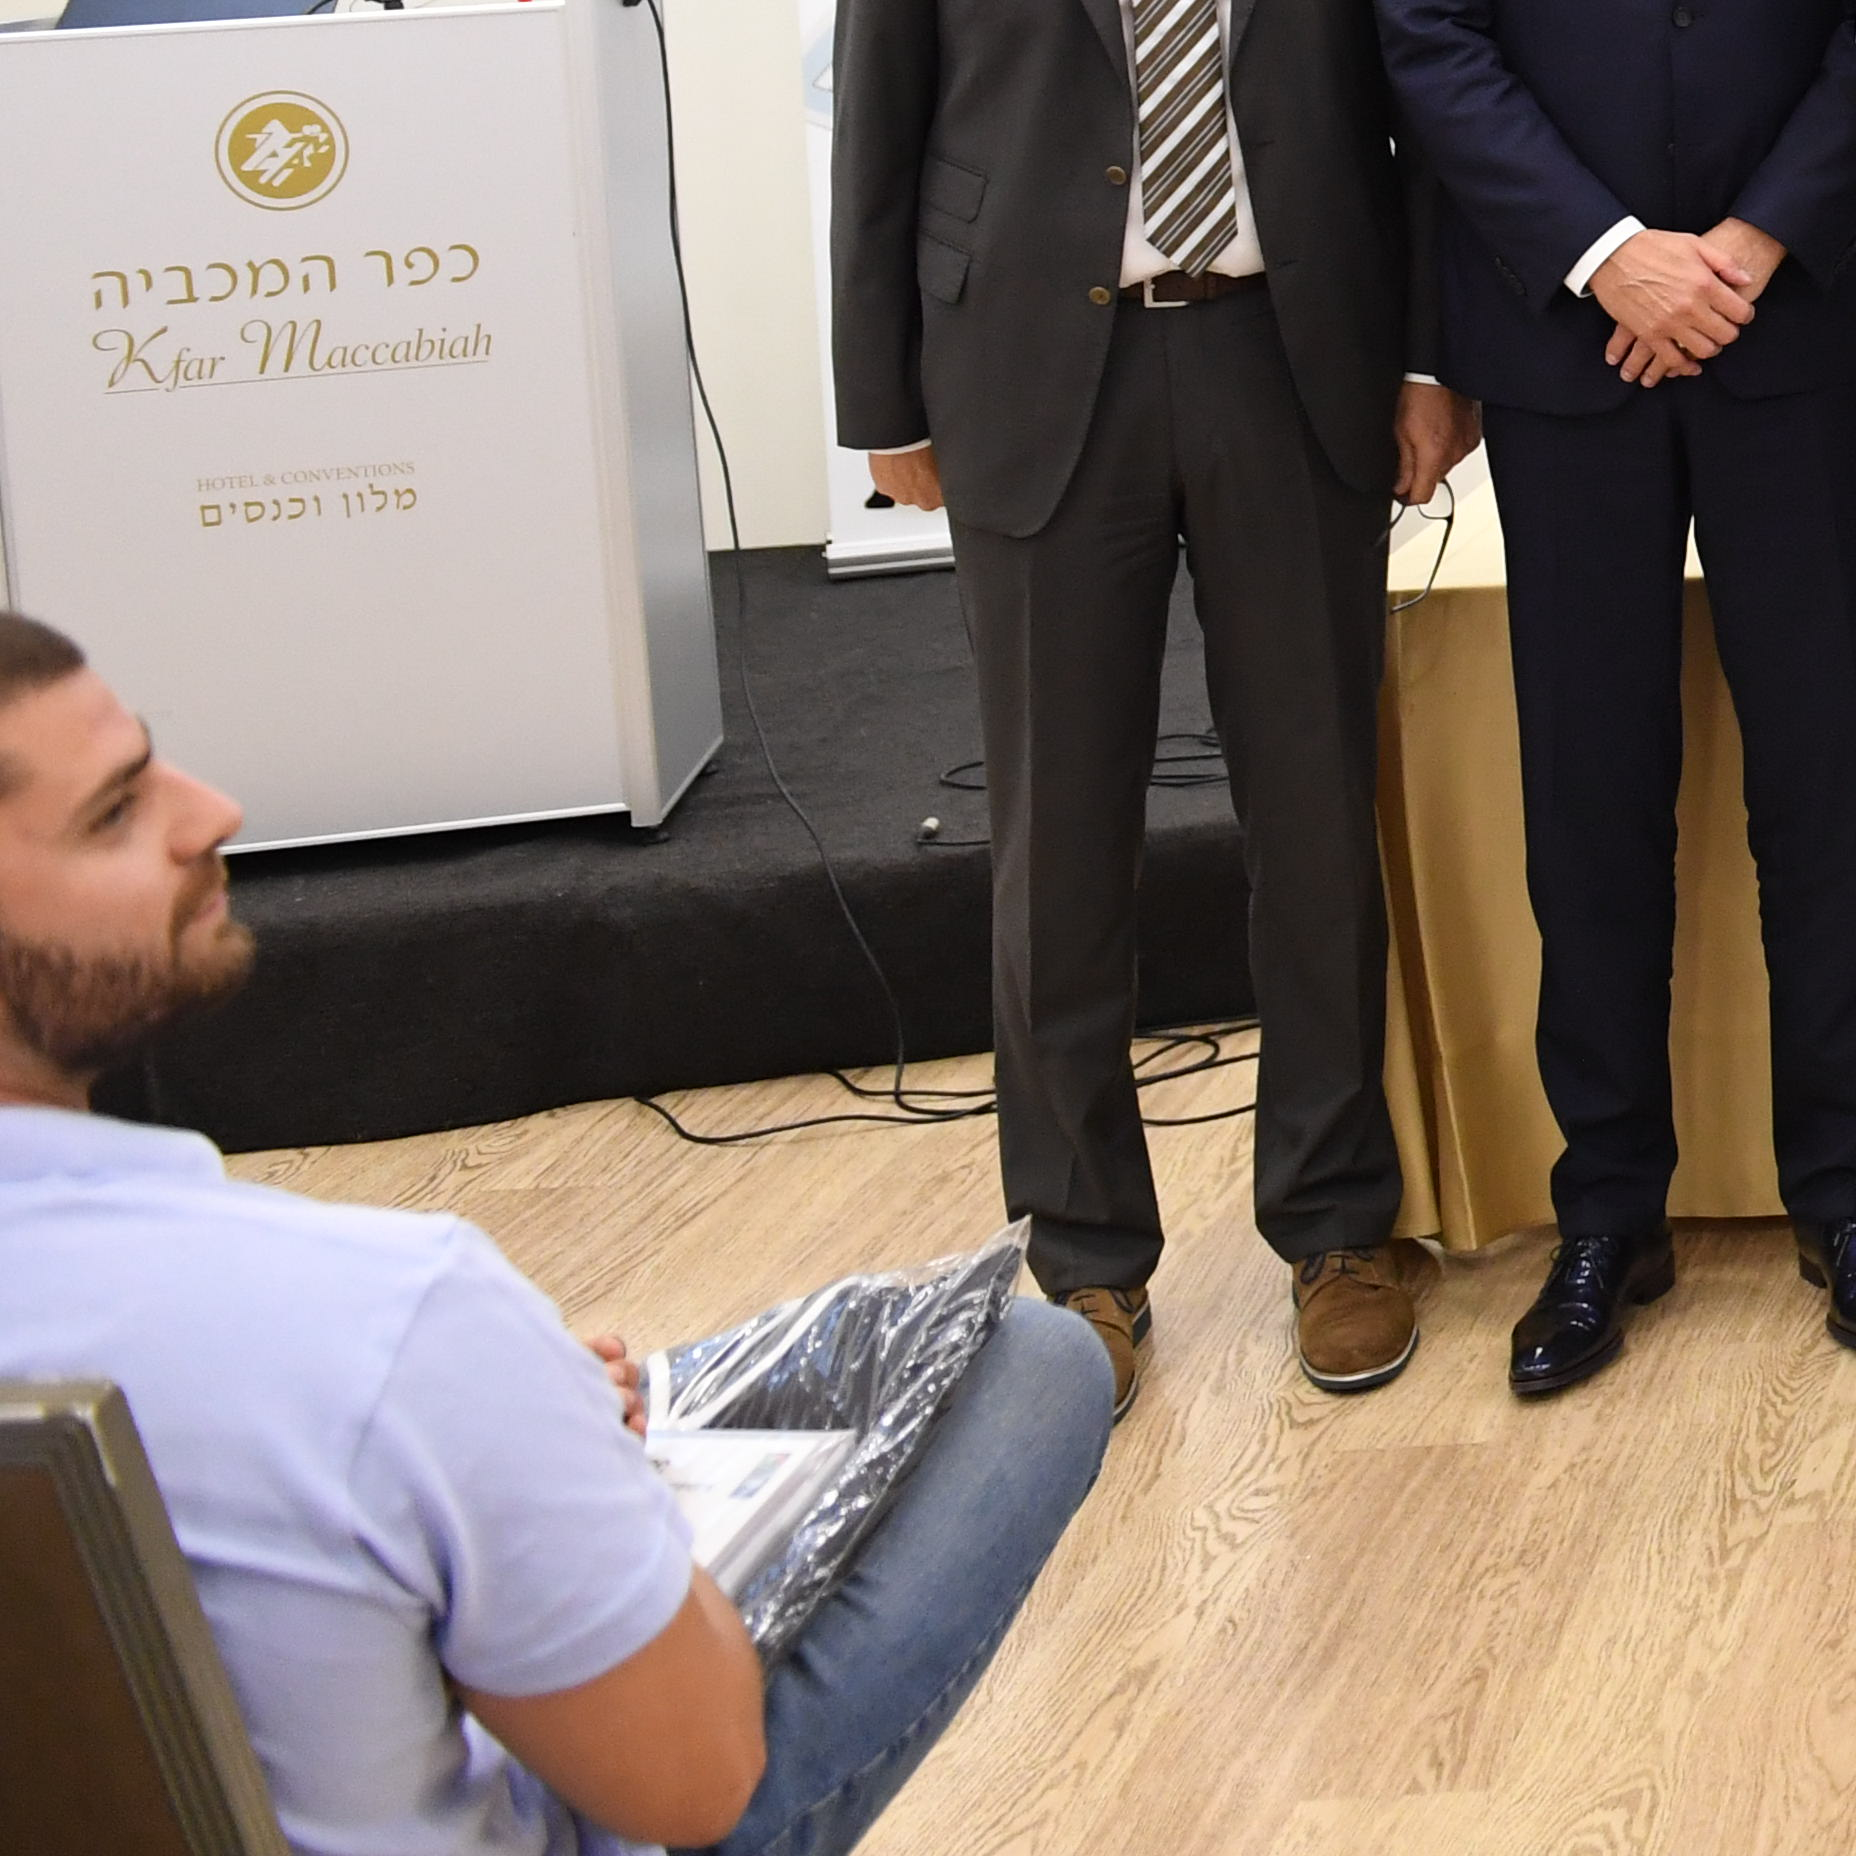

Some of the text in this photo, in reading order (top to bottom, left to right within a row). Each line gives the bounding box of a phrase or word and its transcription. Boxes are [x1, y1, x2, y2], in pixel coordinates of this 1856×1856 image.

[91, 243, 480, 311] כפר המכביה
[92, 318, 492, 393] Kfar Maccabiah
[196, 462, 416, 492] HOTEL & CONVENTIONS
[199, 483, 418, 527] מלון וכנסים
